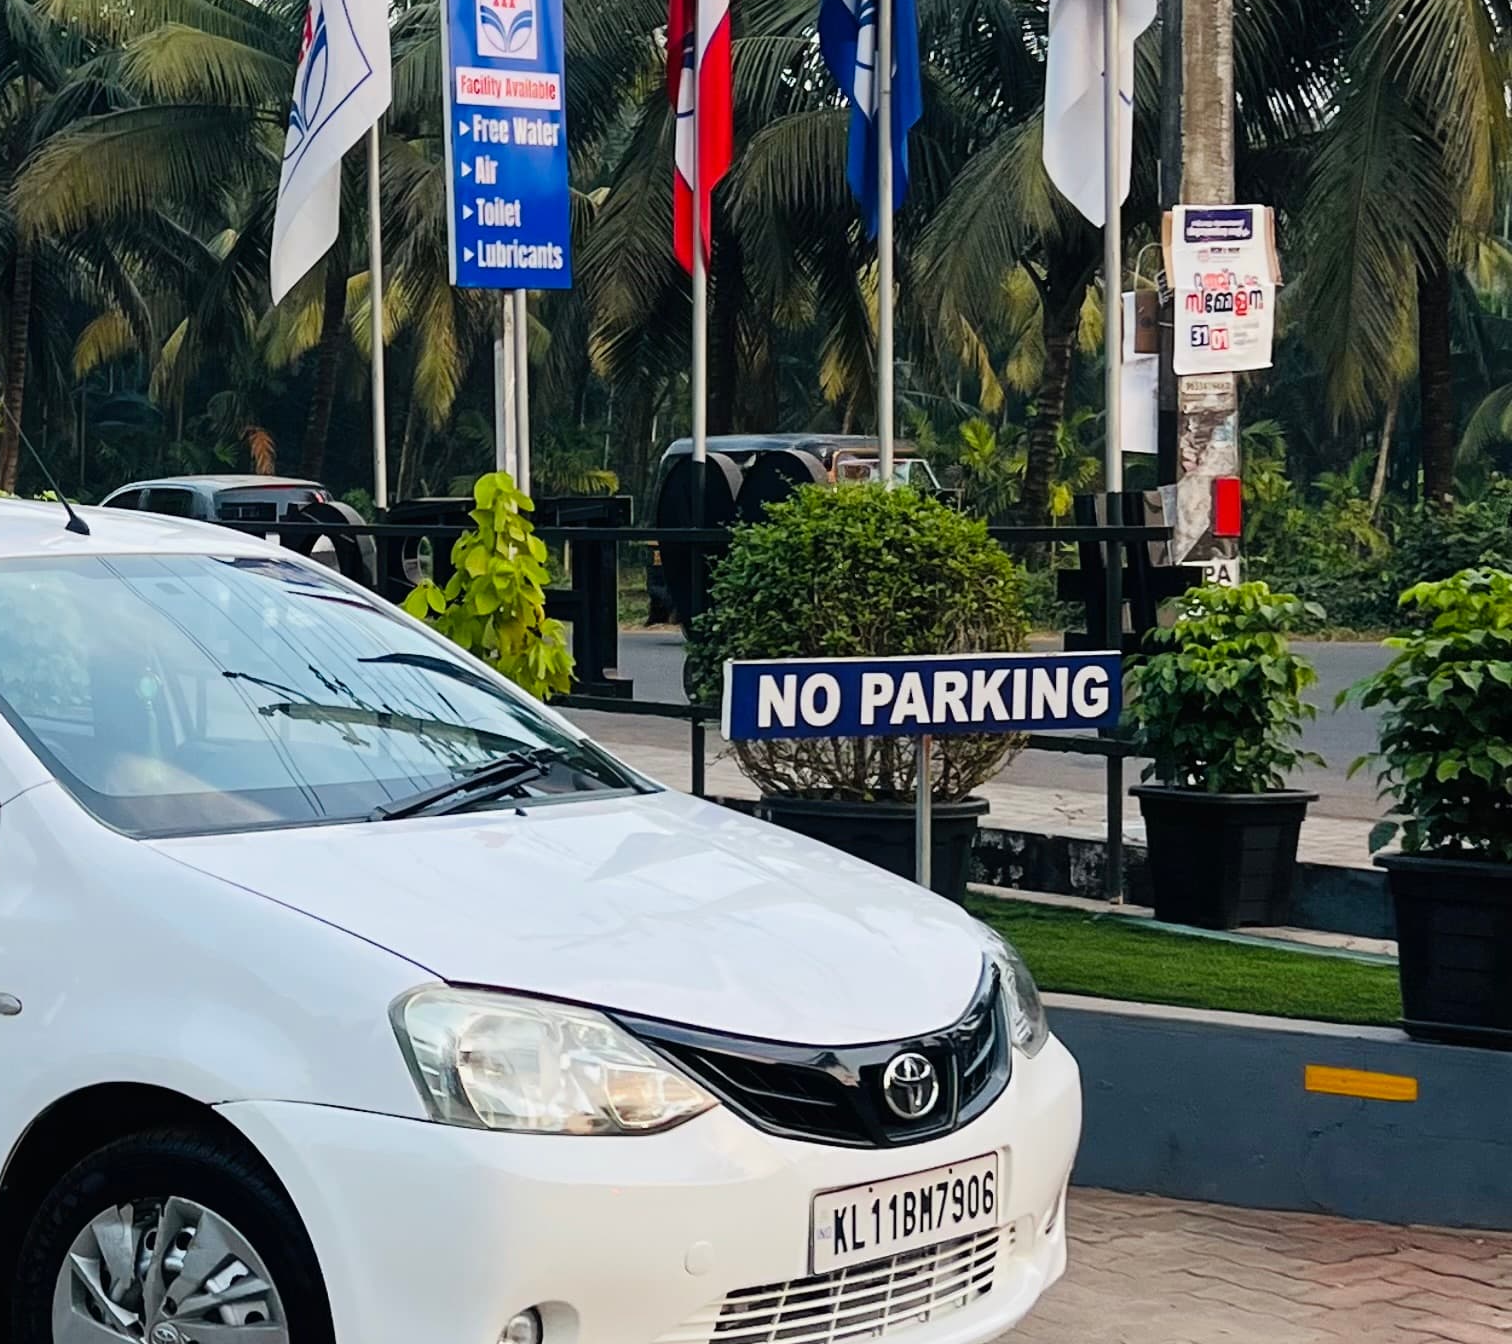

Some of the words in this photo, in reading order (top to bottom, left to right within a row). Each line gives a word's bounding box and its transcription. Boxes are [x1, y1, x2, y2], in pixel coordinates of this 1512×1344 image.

[460, 74, 502, 99] Facility
[505, 76, 556, 101] Available
[473, 113, 509, 144] Free
[513, 116, 560, 147] Water
[474, 155, 498, 185] Air
[476, 197, 522, 227] Toilet
[477, 239, 564, 270] Lubricants
[757, 672, 841, 728] NO
[860, 664, 1110, 726] PARKING
[834, 1170, 994, 1256] KL11BM7906
